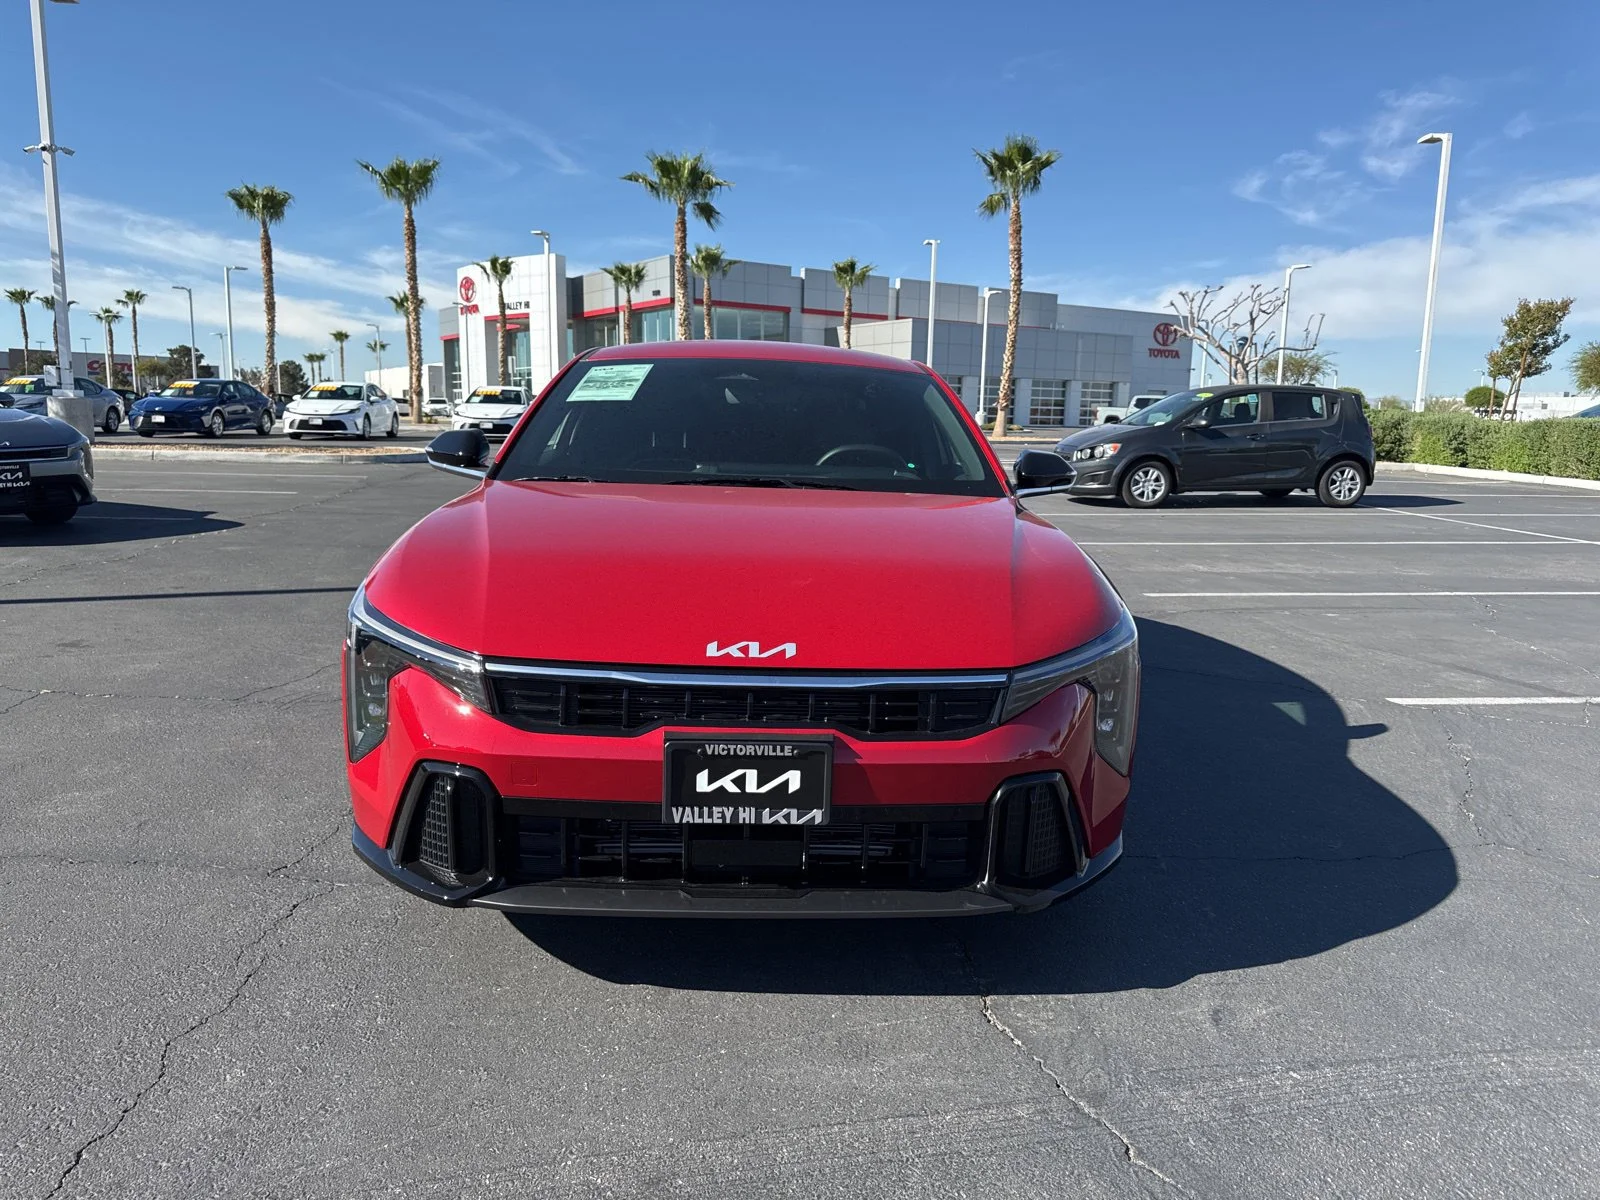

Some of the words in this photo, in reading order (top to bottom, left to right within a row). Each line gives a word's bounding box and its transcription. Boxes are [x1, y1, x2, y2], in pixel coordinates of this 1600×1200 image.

[1148, 348, 1180, 359] TOYOTA
[706, 641, 797, 659] KIA
[705, 744, 793, 756] VICTORVILLE
[696, 768, 801, 794] KIA
[672, 806, 735, 824] VALLEY
[738, 807, 756, 824] HI
[762, 808, 823, 825] KIA
